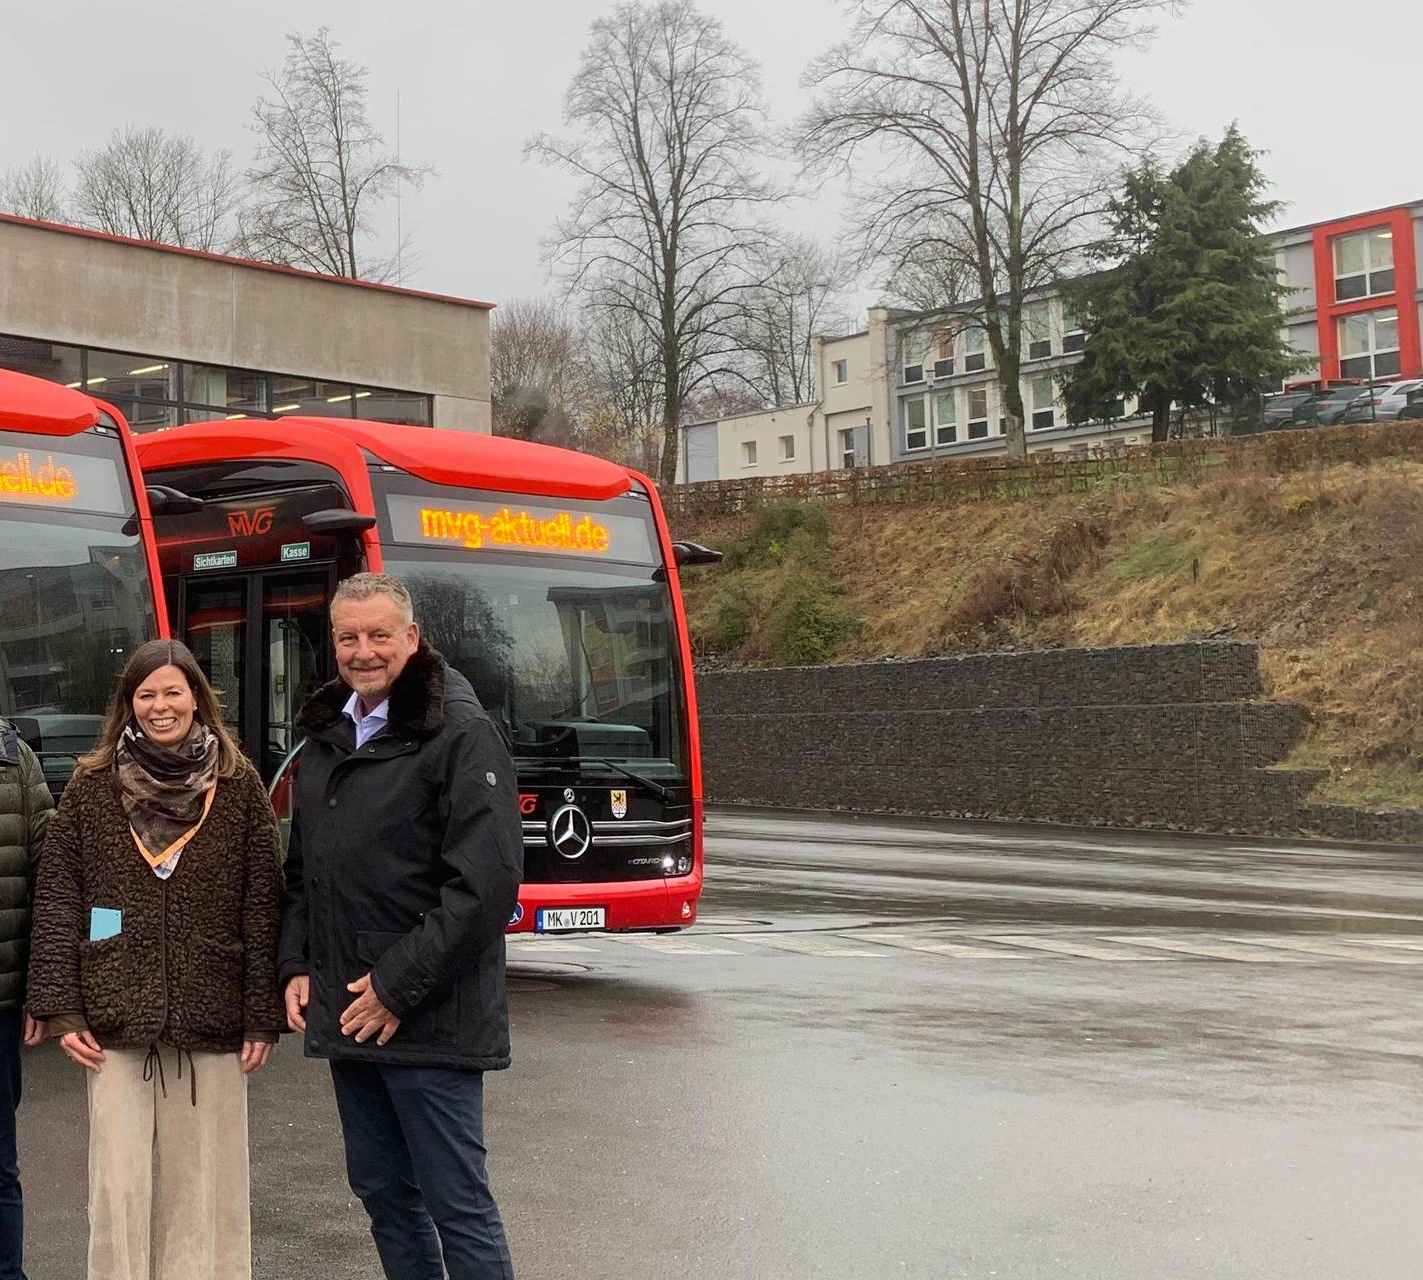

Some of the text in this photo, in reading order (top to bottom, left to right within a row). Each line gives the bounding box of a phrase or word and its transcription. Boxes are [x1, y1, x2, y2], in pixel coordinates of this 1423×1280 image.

[226, 504, 277, 537] MVG
[420, 508, 609, 551] mvg-aktuell.de
[195, 554, 235, 568] Sichtkarten
[283, 546, 307, 559] Kasse
[547, 910, 600, 927] MK V 201
